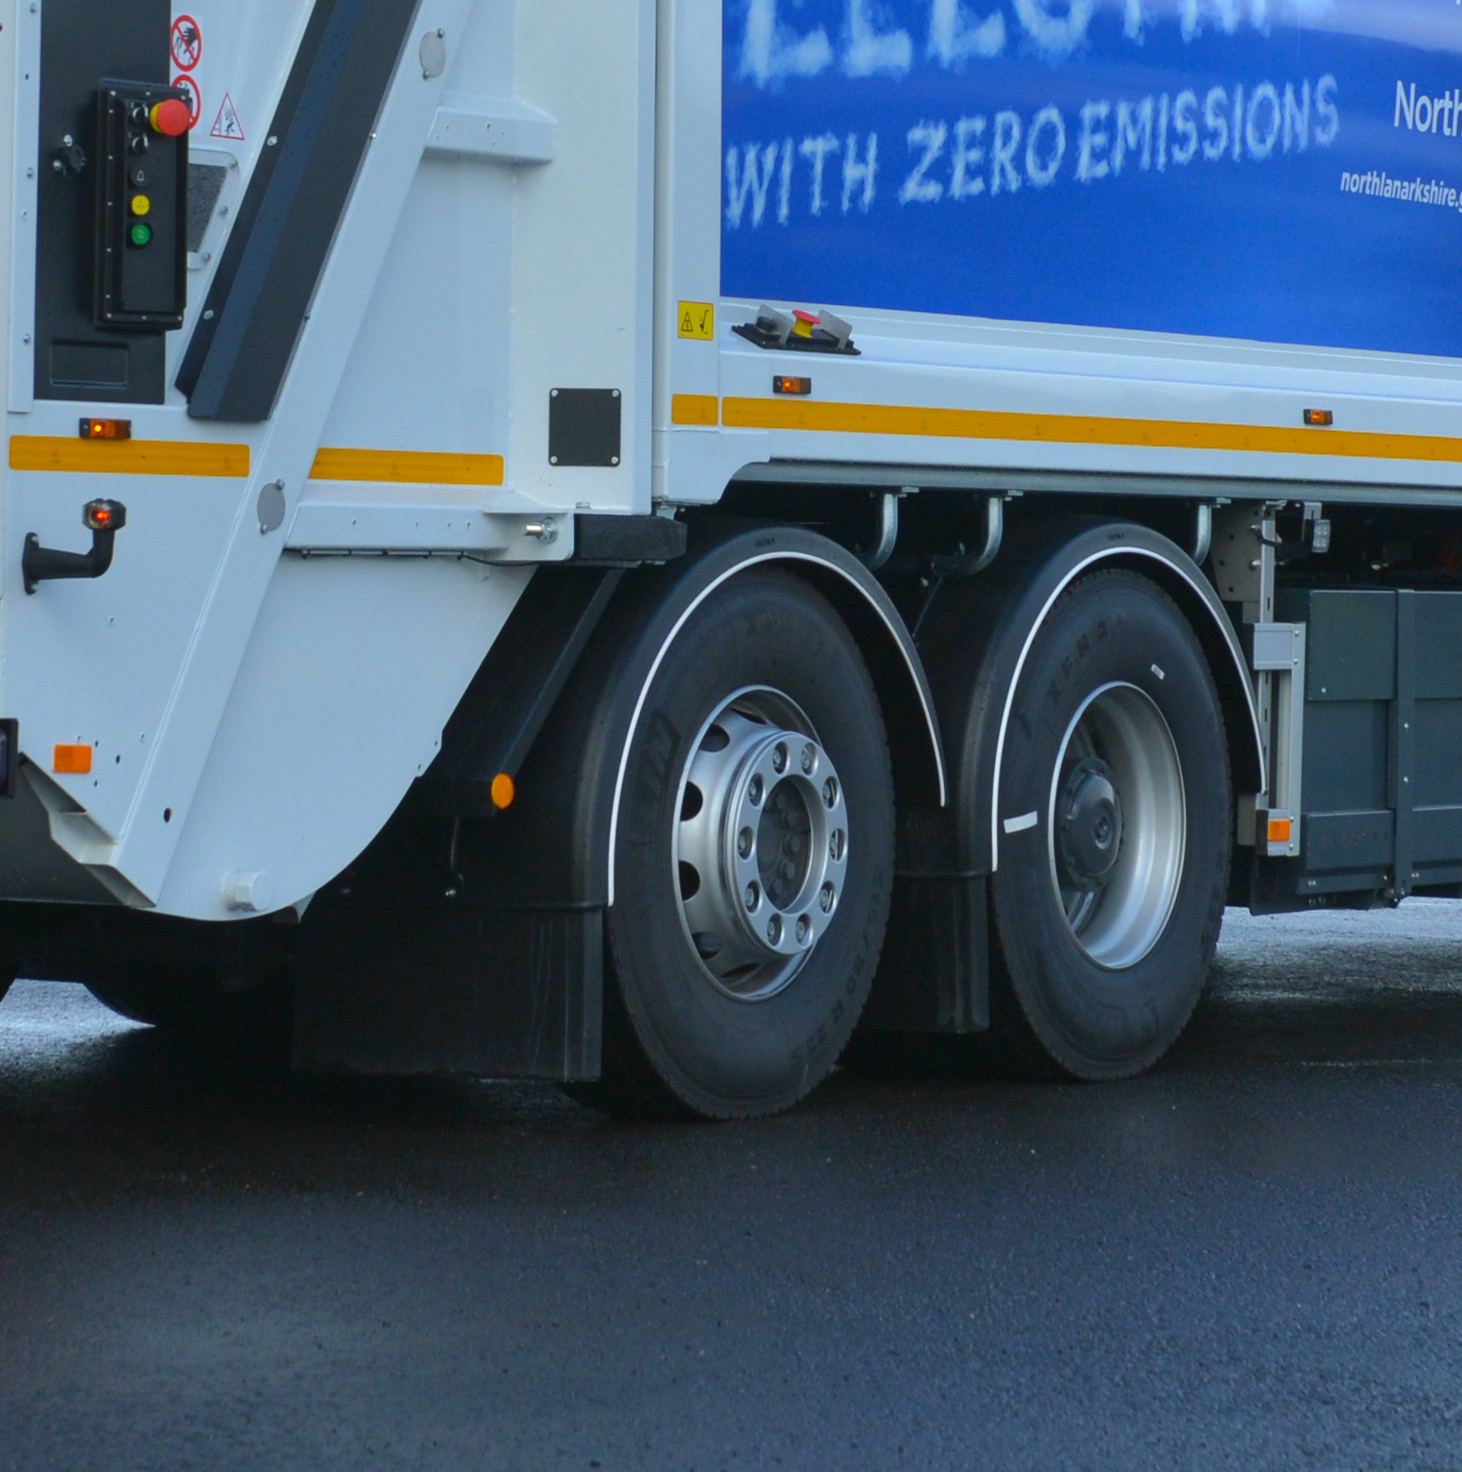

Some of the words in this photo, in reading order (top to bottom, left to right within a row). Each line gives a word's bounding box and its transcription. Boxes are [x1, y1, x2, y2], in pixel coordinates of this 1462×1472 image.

[725, 130, 878, 228] WITH
[898, 104, 1067, 206] ZERO
[1074, 74, 1338, 183] EMISSIONS
